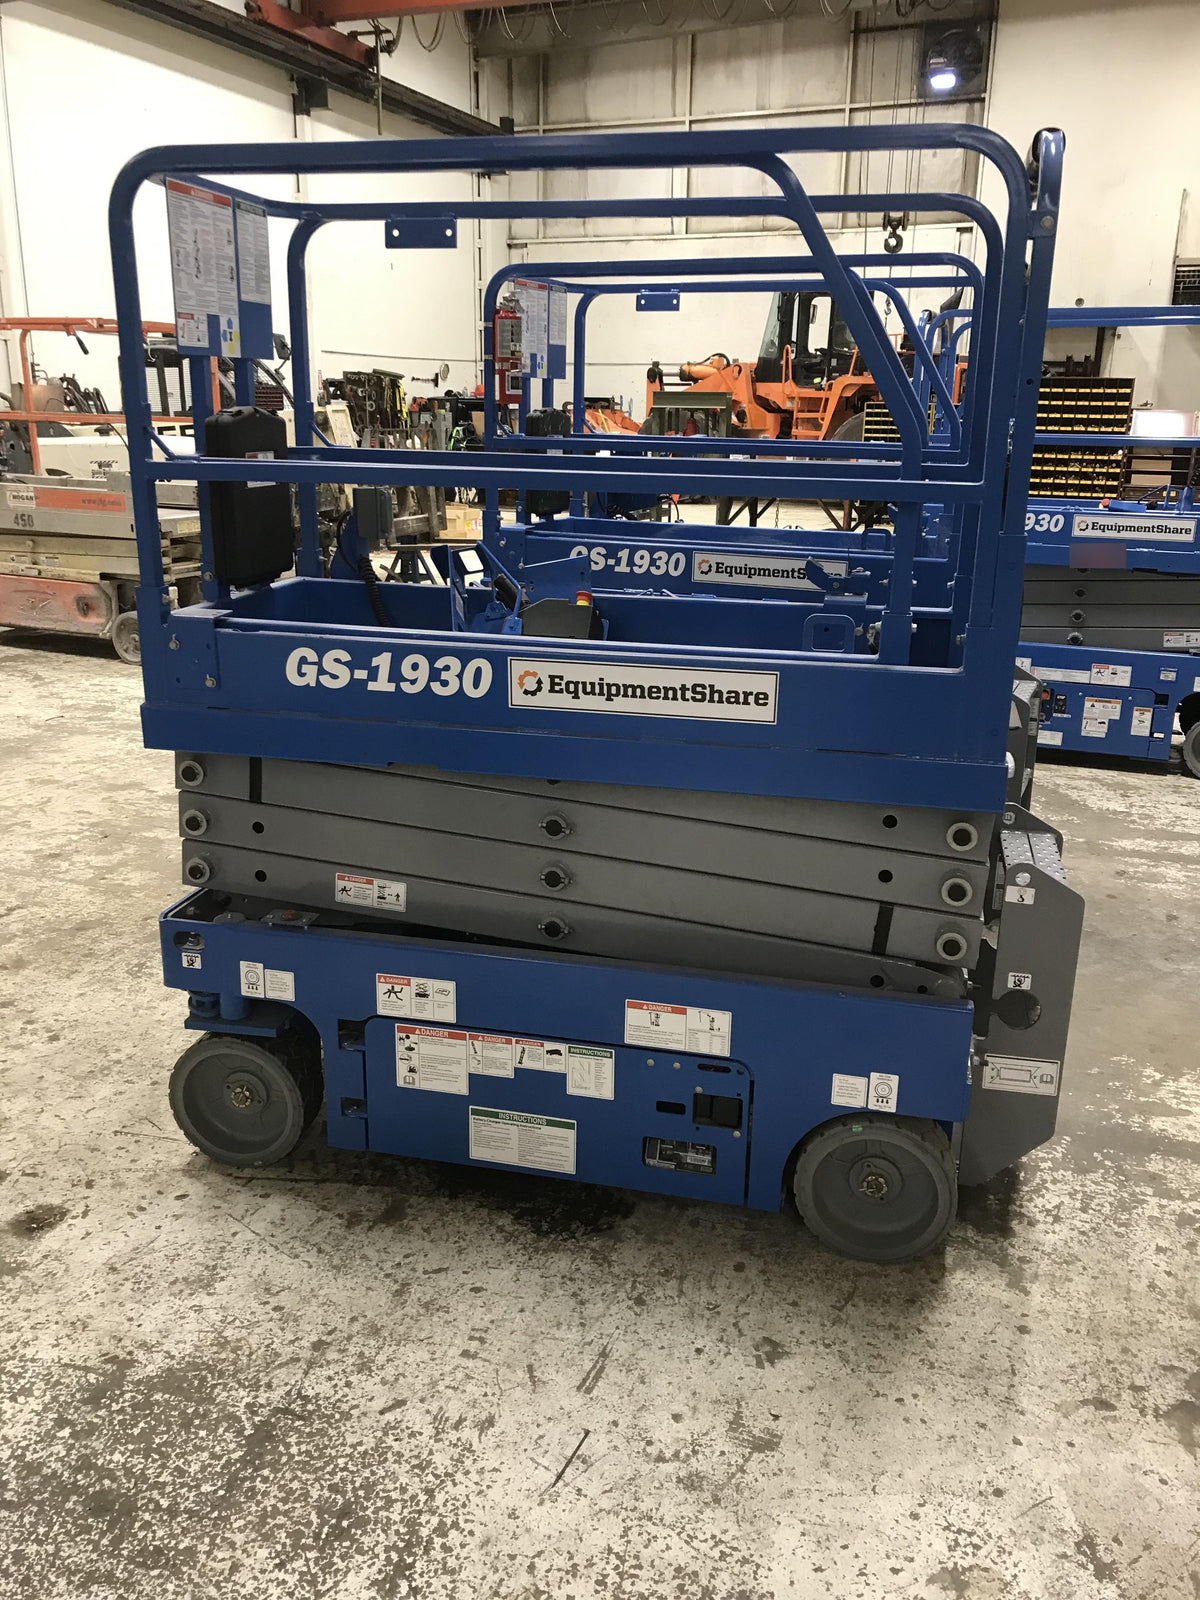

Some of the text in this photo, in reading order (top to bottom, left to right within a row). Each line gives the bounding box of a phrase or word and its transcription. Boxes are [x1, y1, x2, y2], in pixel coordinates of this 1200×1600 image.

[1090, 521, 1192, 535] EquipmentShare
[714, 560, 842, 580] EquipmentS
[285, 647, 493, 699] GS-1930
[547, 674, 770, 709] EquipmentShare
[385, 977, 409, 985] DANGER
[648, 1003, 672, 1012] DANGER
[421, 1028, 449, 1038] DANGER
[484, 1036, 506, 1044] DANGER
[570, 1047, 611, 1058] INSTRUCTIONS
[498, 1112, 547, 1126] INSTRUCTIONS
